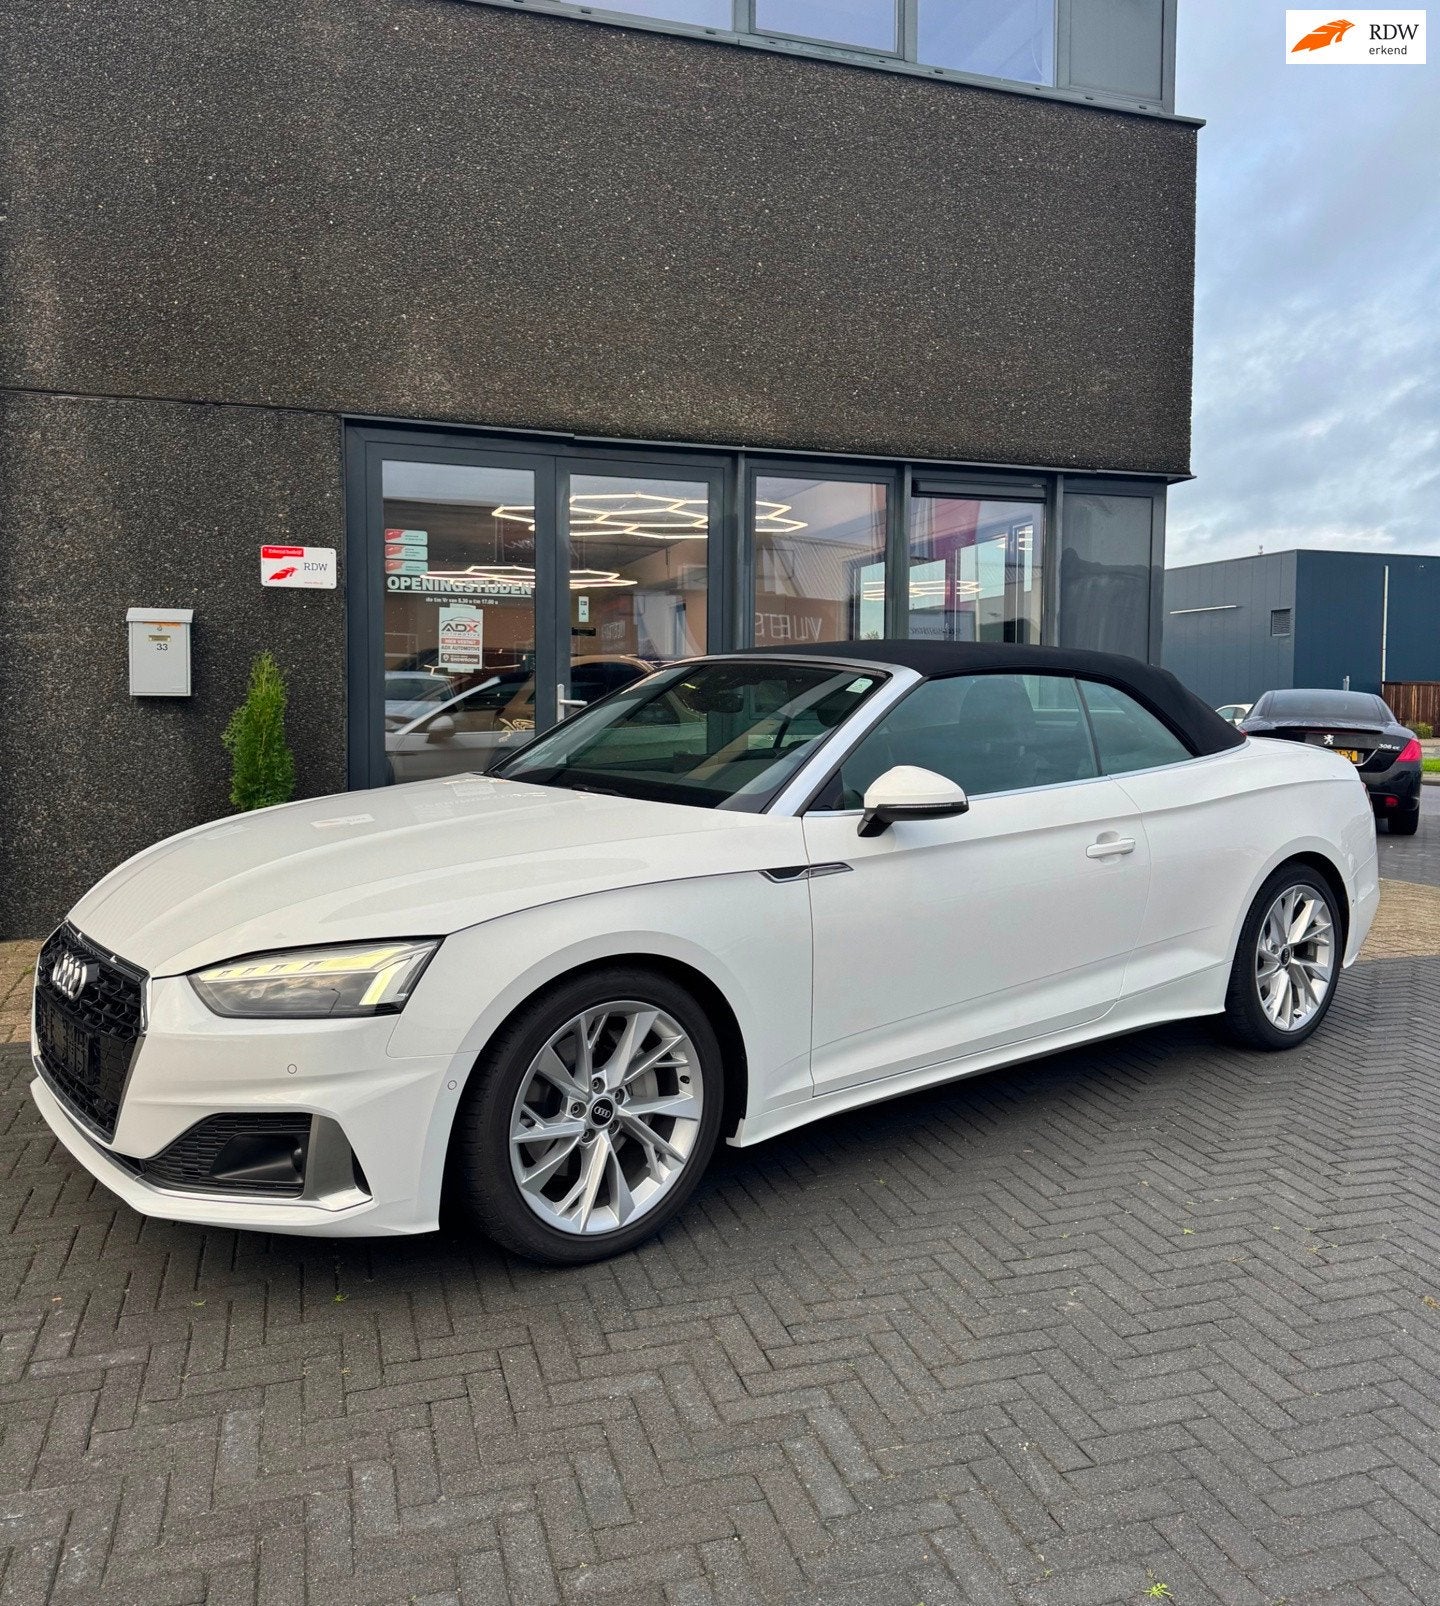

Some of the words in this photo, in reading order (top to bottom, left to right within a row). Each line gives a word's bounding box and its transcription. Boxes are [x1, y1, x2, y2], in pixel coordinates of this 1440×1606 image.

[304, 562, 328, 571] RDW
[387, 576, 532, 595] OPENINGSTIJDEN
[441, 623, 479, 633] ADX
[156, 643, 168, 651] 33
